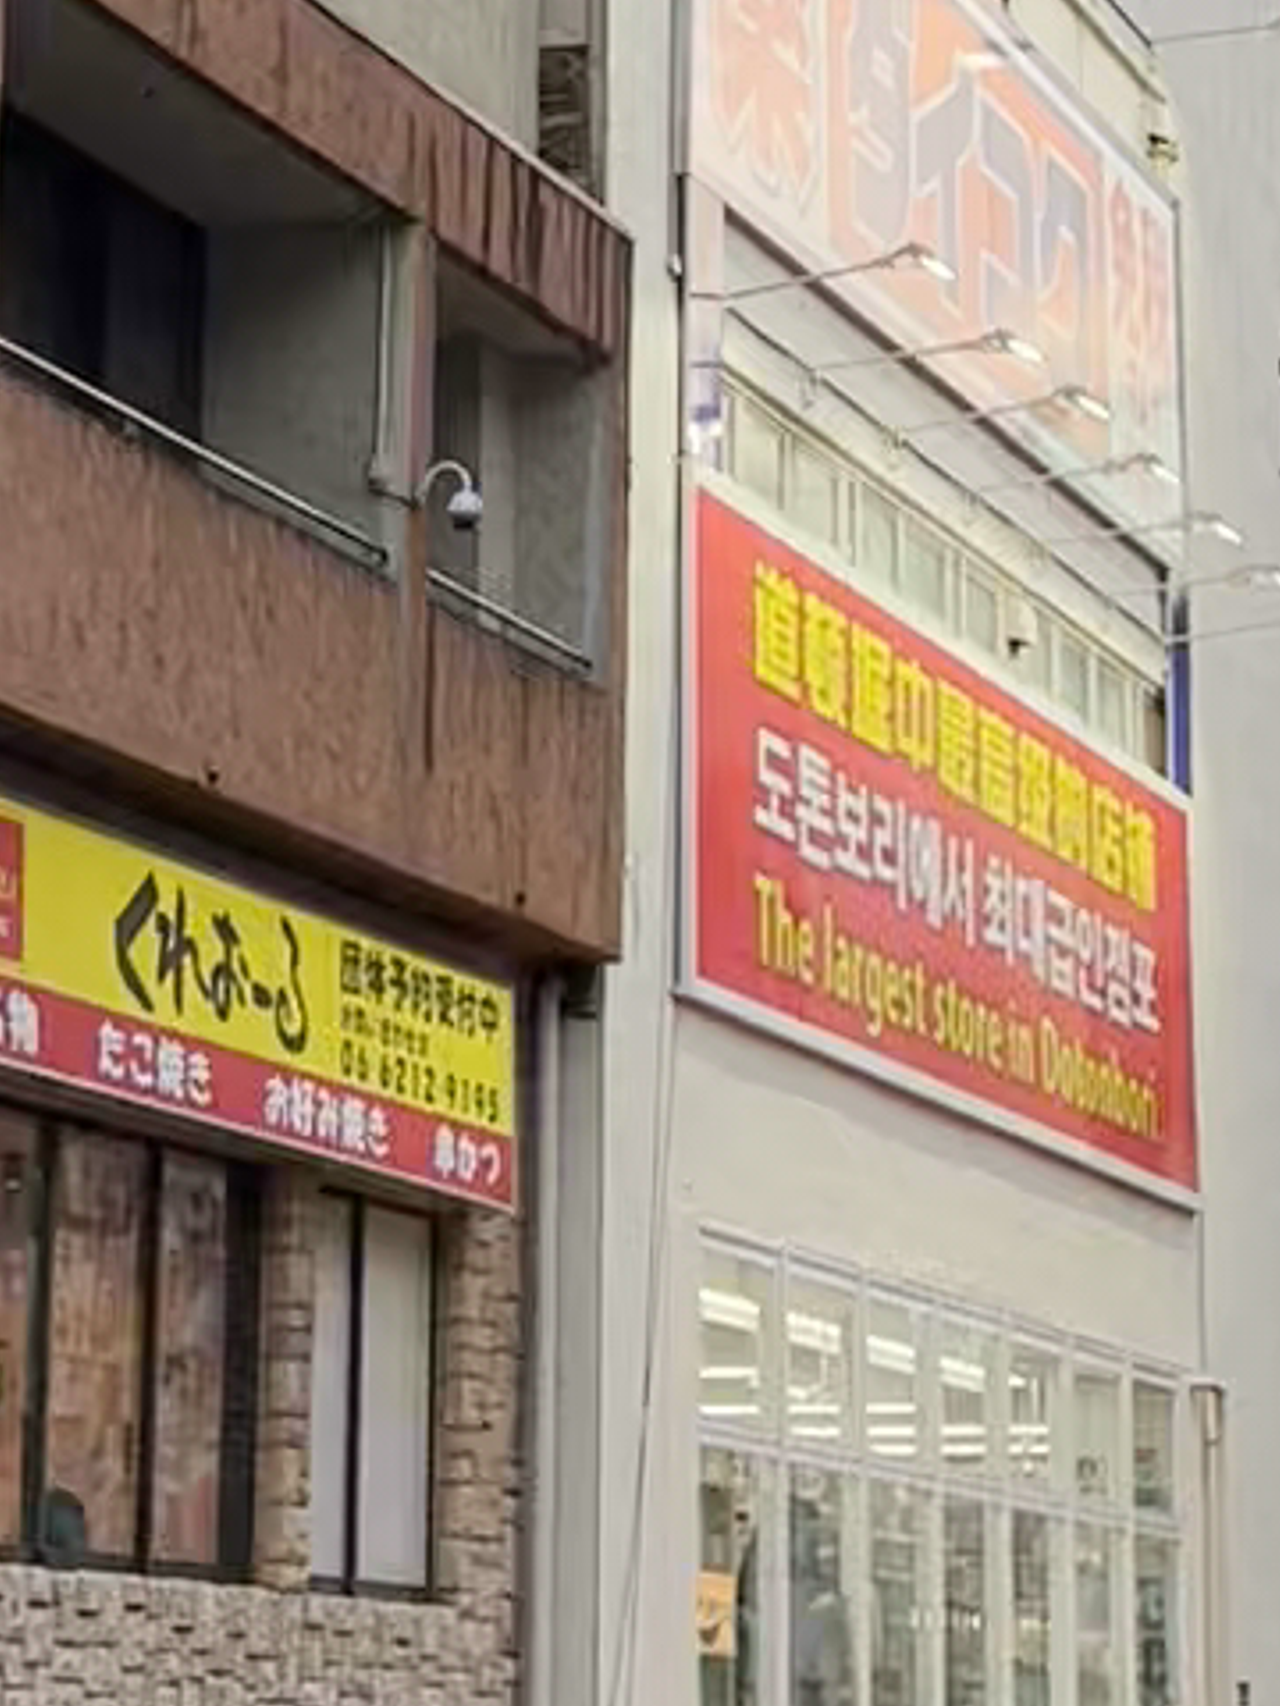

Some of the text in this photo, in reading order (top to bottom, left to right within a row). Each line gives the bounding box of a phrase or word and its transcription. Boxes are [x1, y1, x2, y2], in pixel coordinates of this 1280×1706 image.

[114, 869, 308, 1054] くれおーる
[754, 871, 815, 984] The
[825, 903, 927, 1037] largest
[933, 981, 1003, 1069] store
[1006, 1000, 1035, 1084] in
[98, 1019, 213, 1108] たこ焼き
[264, 1073, 391, 1159] お好み焼き
[435, 1123, 502, 1184] 串かつ
